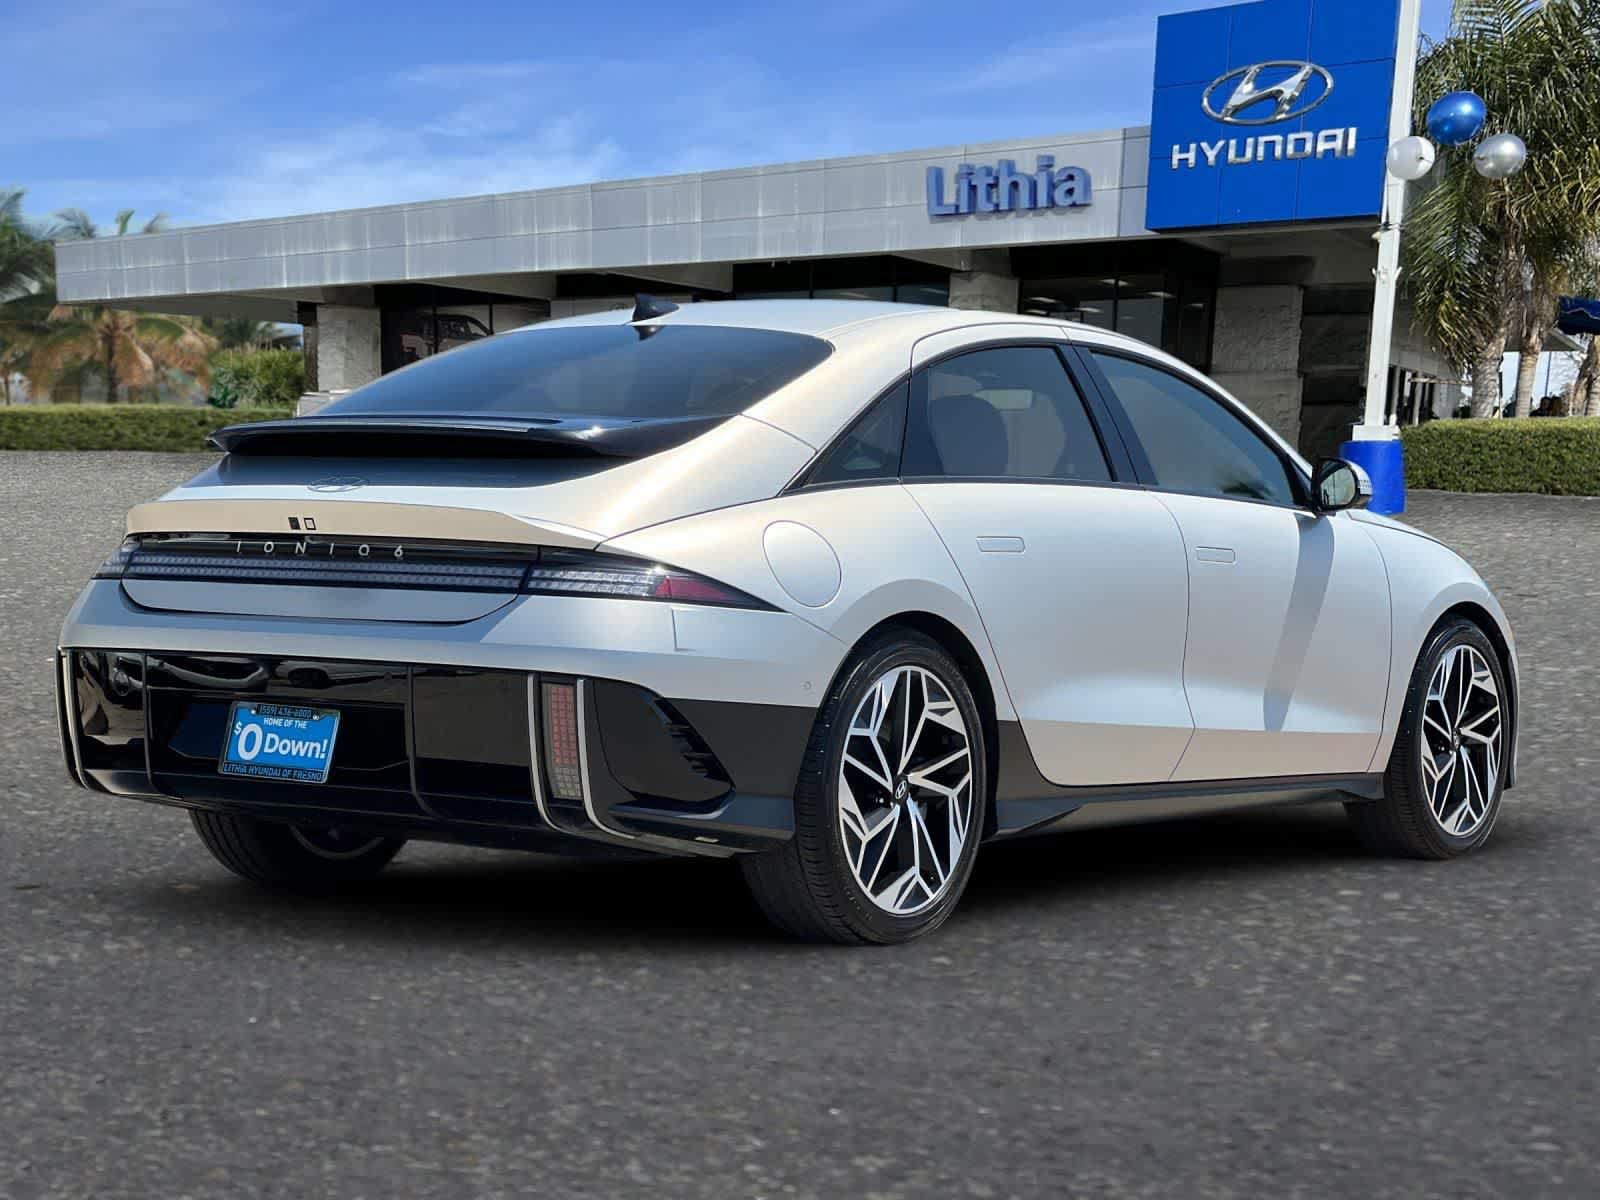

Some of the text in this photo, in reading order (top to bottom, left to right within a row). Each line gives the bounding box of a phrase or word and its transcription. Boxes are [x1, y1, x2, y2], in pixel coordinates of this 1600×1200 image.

[1171, 126, 1357, 170] HYUNDAI
[926, 154, 1092, 217] Lithia
[263, 717, 308, 729] HOME OF THE
[263, 732, 329, 760] Down!
[224, 763, 322, 781] LITHIA HYUNDAI OF FRESNO
